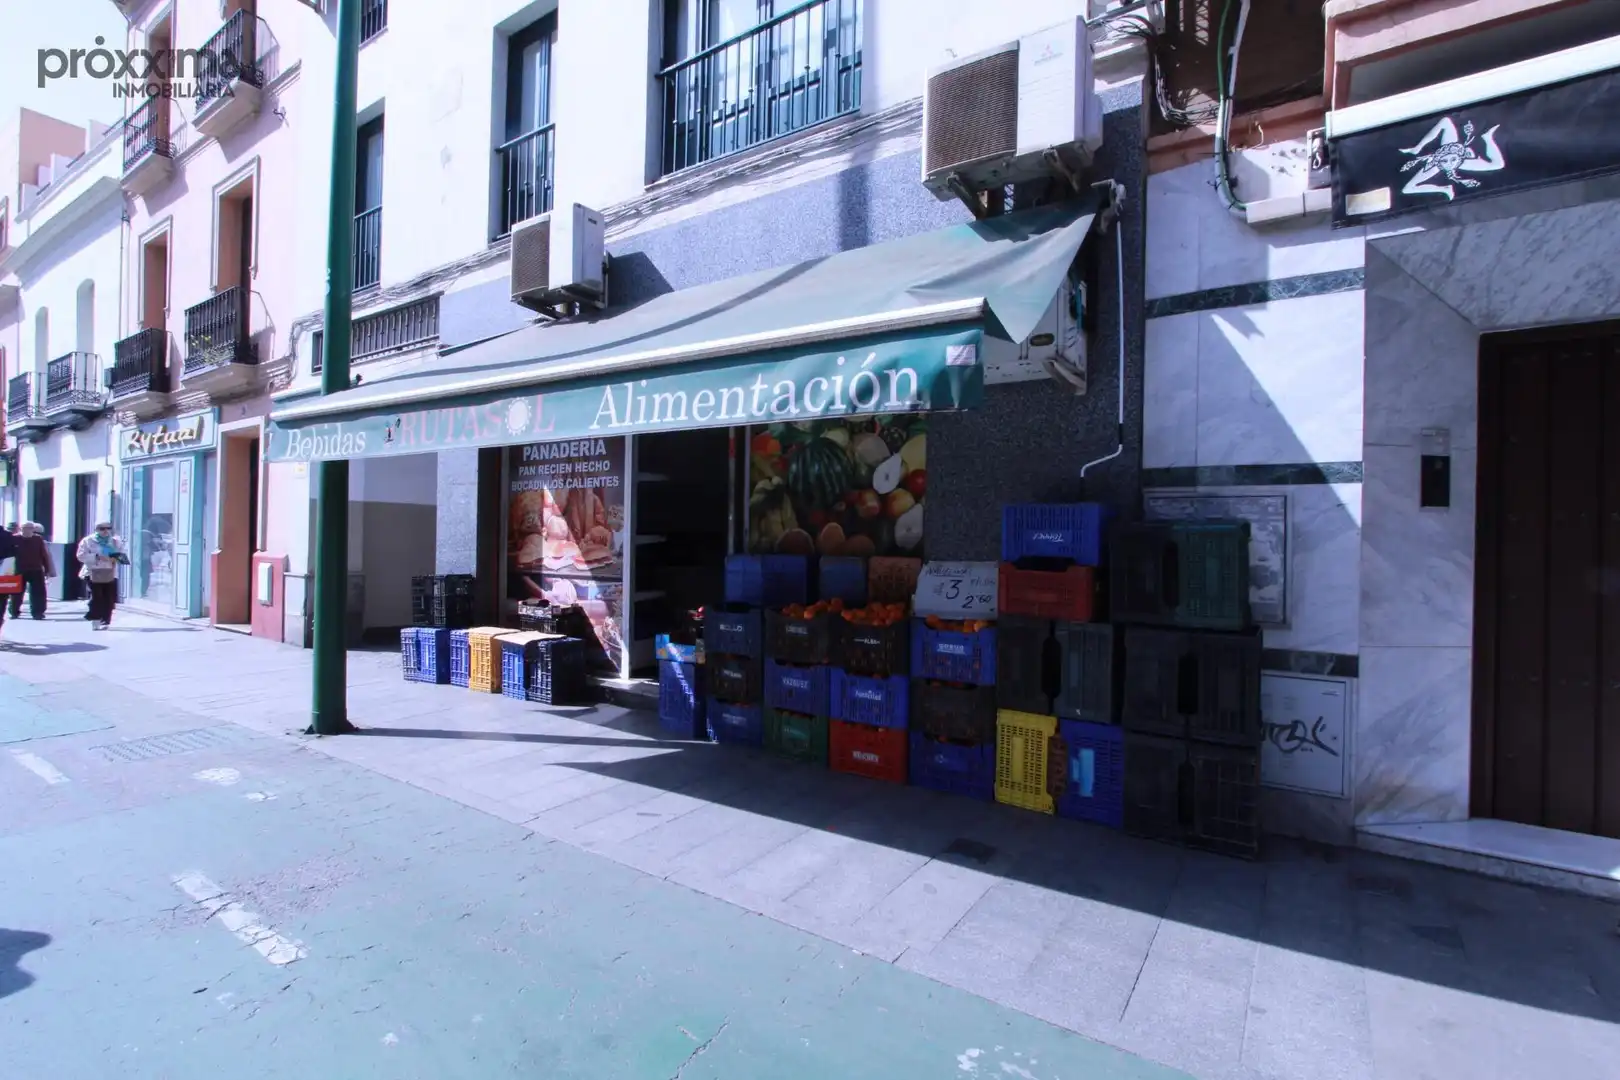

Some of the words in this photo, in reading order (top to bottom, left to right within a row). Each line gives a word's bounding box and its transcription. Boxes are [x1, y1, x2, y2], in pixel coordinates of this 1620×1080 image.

[285, 423, 367, 459] Bebidas
[589, 351, 925, 431] Alimentación
[518, 465, 536, 477] PAN
[575, 459, 611, 473] HECHO
[566, 475, 620, 490] CALIENTES
